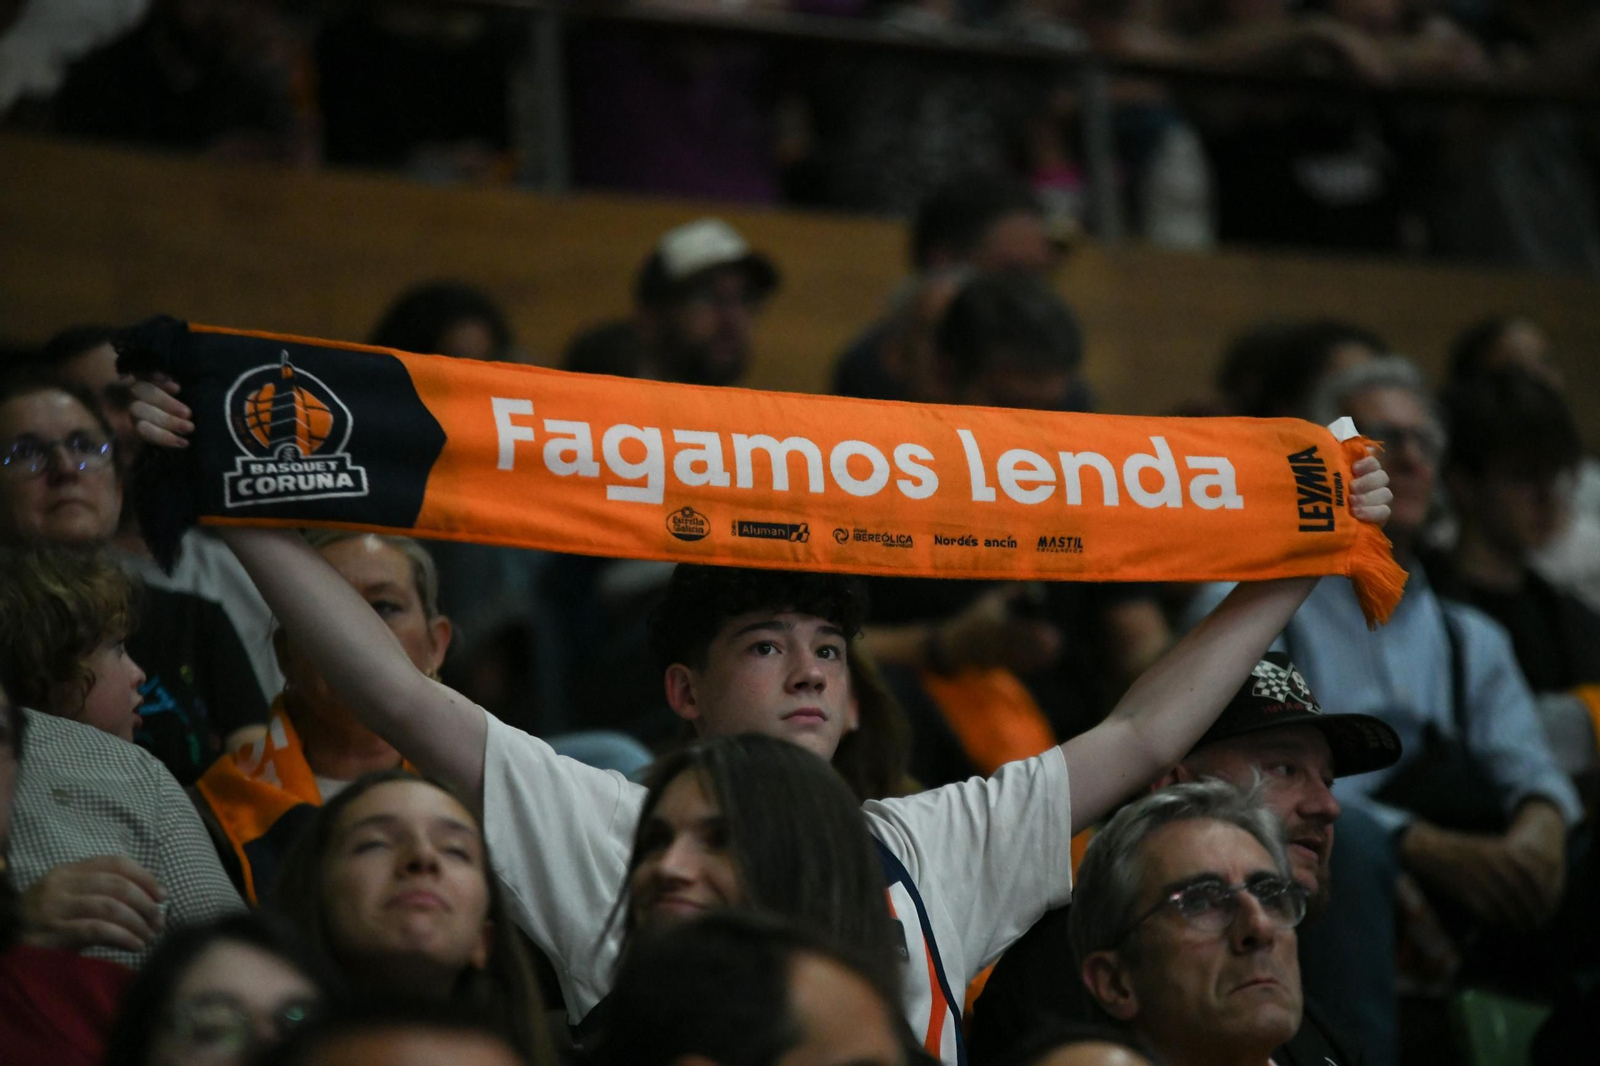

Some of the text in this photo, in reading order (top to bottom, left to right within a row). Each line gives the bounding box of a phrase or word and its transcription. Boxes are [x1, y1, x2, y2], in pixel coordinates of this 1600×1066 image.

[491, 396, 1244, 510] Fagamos lenda
[250, 461, 339, 475] BASQUET
[237, 472, 355, 496] CORUÑA
[1287, 446, 1336, 532] LEYMA
[742, 524, 786, 537] Aluman
[853, 532, 914, 544] IBEREÓLICA
[934, 534, 1018, 548] Nordés ancín
[1037, 535, 1084, 549] MASTIL
